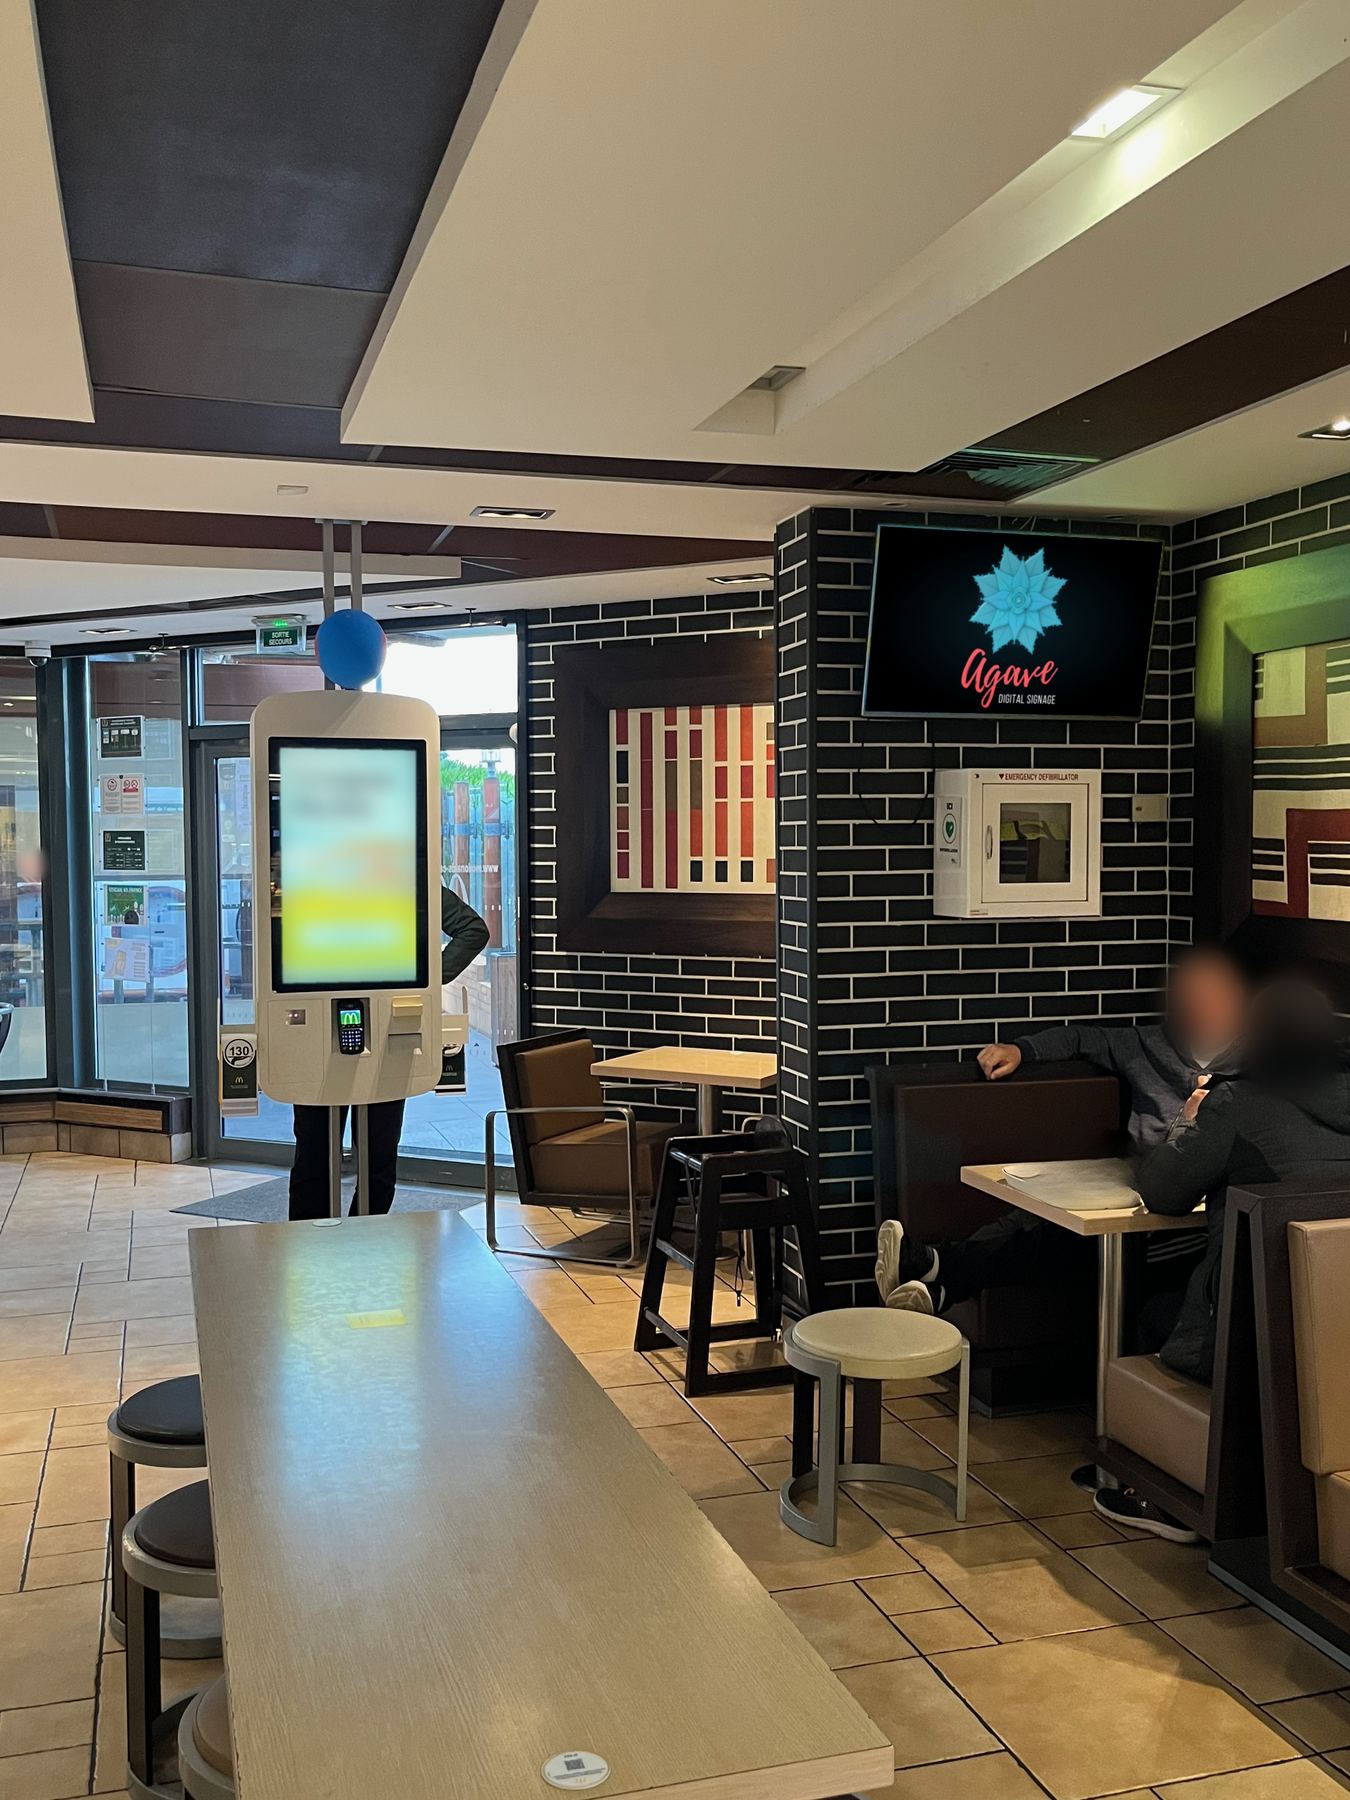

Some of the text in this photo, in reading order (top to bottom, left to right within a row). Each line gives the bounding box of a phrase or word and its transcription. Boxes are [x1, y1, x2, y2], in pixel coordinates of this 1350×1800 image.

[271, 631, 290, 639] SORTIE
[268, 638, 292, 646] SECOURS
[961, 648, 1058, 708] Agave
[998, 693, 1057, 705] DIGITAL SIGNAGE
[1005, 773, 1079, 781] EMERGENCY DEFIBRILLATOR
[229, 1046, 250, 1056] 130
